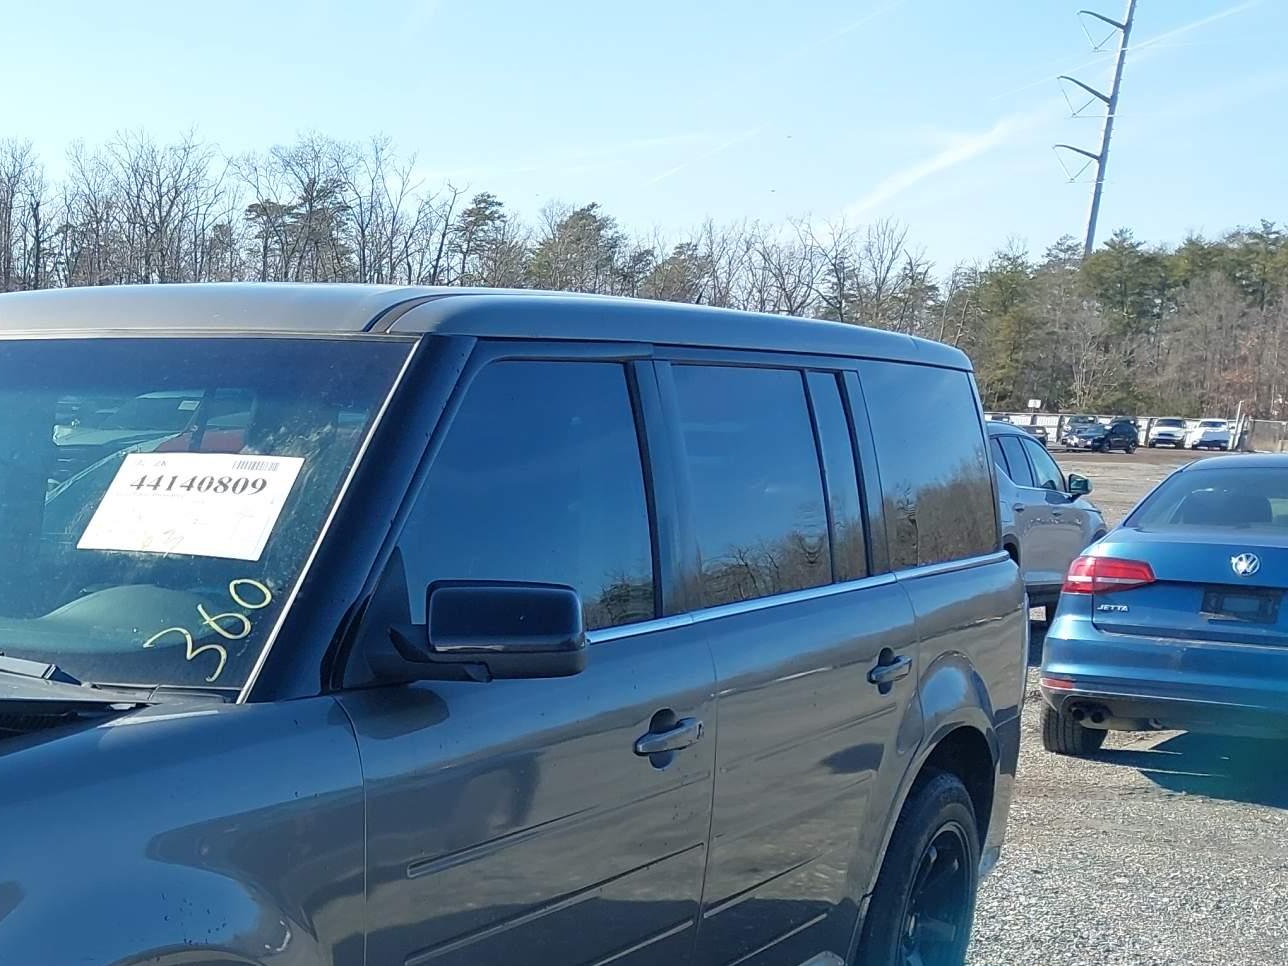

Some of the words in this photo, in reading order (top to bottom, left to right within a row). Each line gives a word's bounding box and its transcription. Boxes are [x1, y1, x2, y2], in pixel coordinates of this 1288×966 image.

[130, 475, 267, 496] 44140809
[1097, 604, 1129, 612] JETTA
[143, 579, 272, 682] 360
